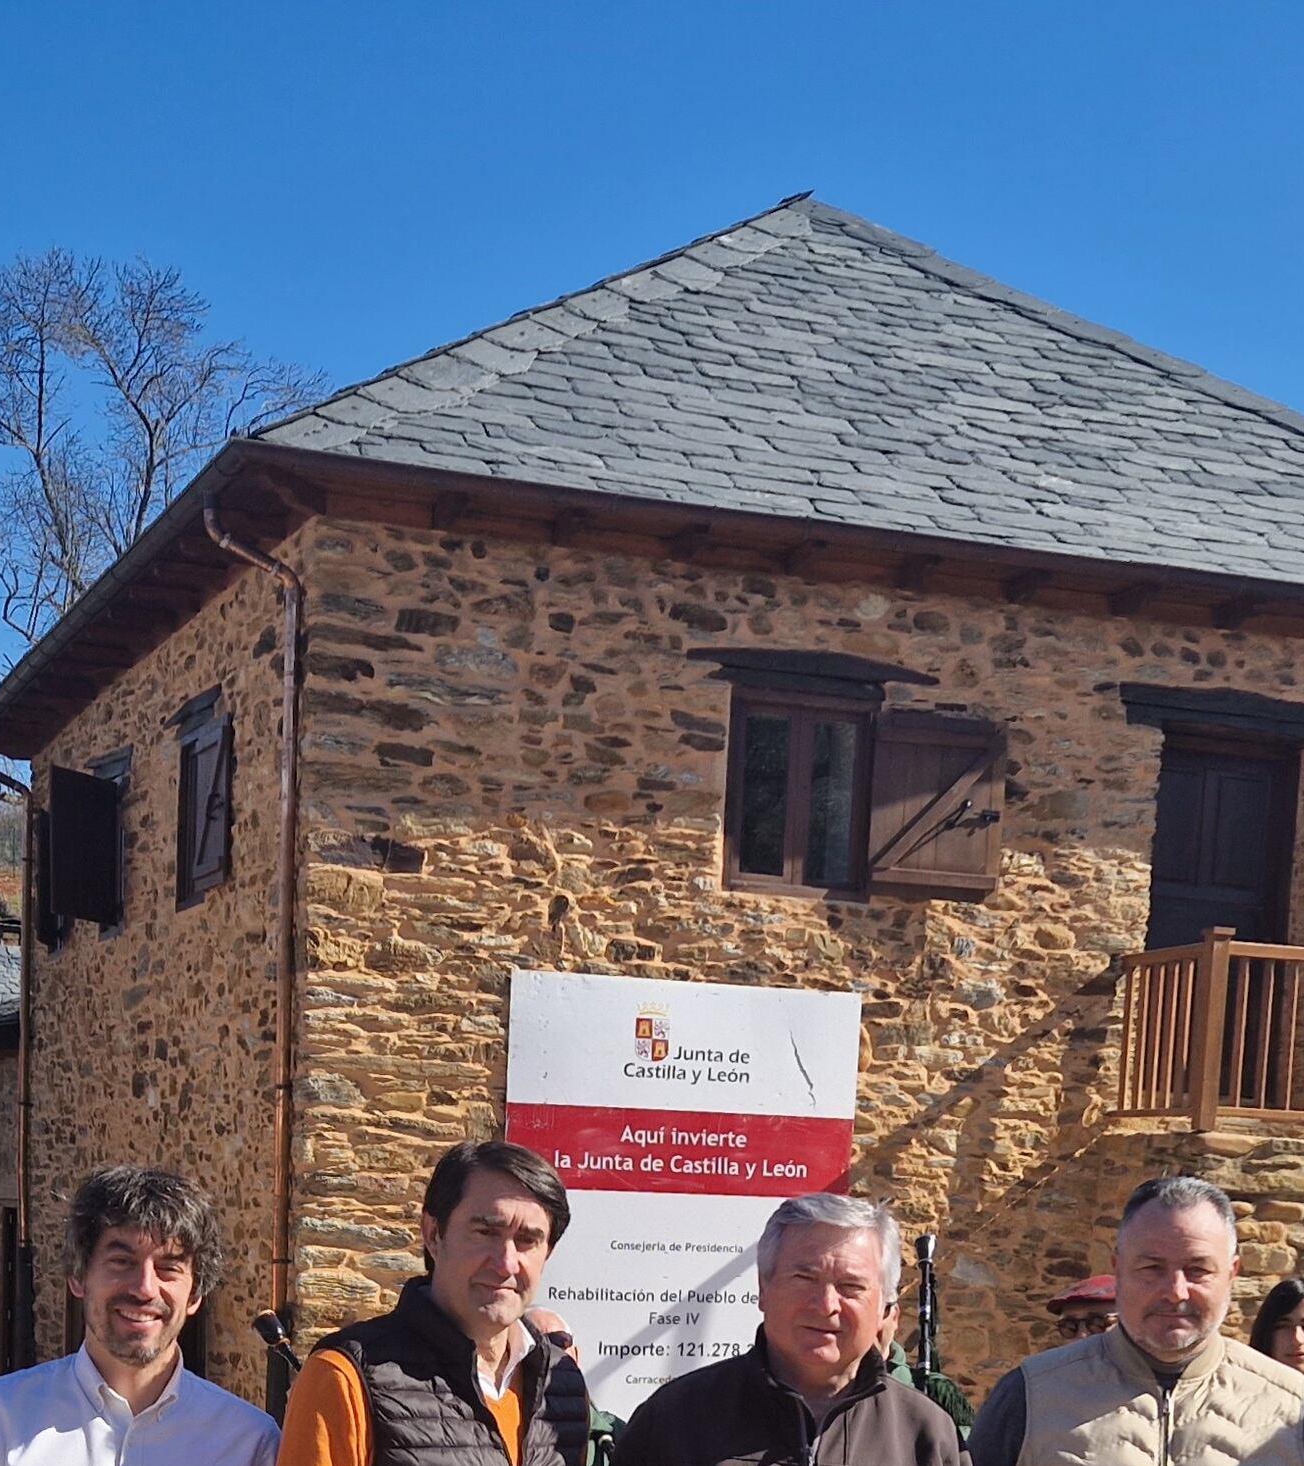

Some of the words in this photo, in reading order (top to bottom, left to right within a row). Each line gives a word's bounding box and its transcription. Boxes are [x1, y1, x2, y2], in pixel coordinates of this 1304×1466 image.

[673, 1046, 723, 1063] Junta
[729, 1049, 750, 1064] de
[623, 1062, 686, 1081] Castilla
[691, 1070, 702, 1084] y
[708, 1067, 750, 1084] León
[620, 1124, 665, 1148] Aquí
[671, 1128, 748, 1148] invierte
[554, 1150, 572, 1168] la
[578, 1151, 633, 1171] Junta
[640, 1153, 664, 1172] de
[670, 1155, 739, 1176] Castilla
[745, 1162, 757, 1180] y
[762, 1159, 808, 1179] León
[669, 1241, 682, 1252] de
[685, 1242, 744, 1254] Presidencia
[548, 1287, 655, 1303] Rehabilitación
[660, 1289, 682, 1304] del
[687, 1290, 736, 1305] Pueblo
[648, 1312, 681, 1325] Fase
[686, 1313, 700, 1325] IV
[598, 1341, 671, 1359] Importe:
